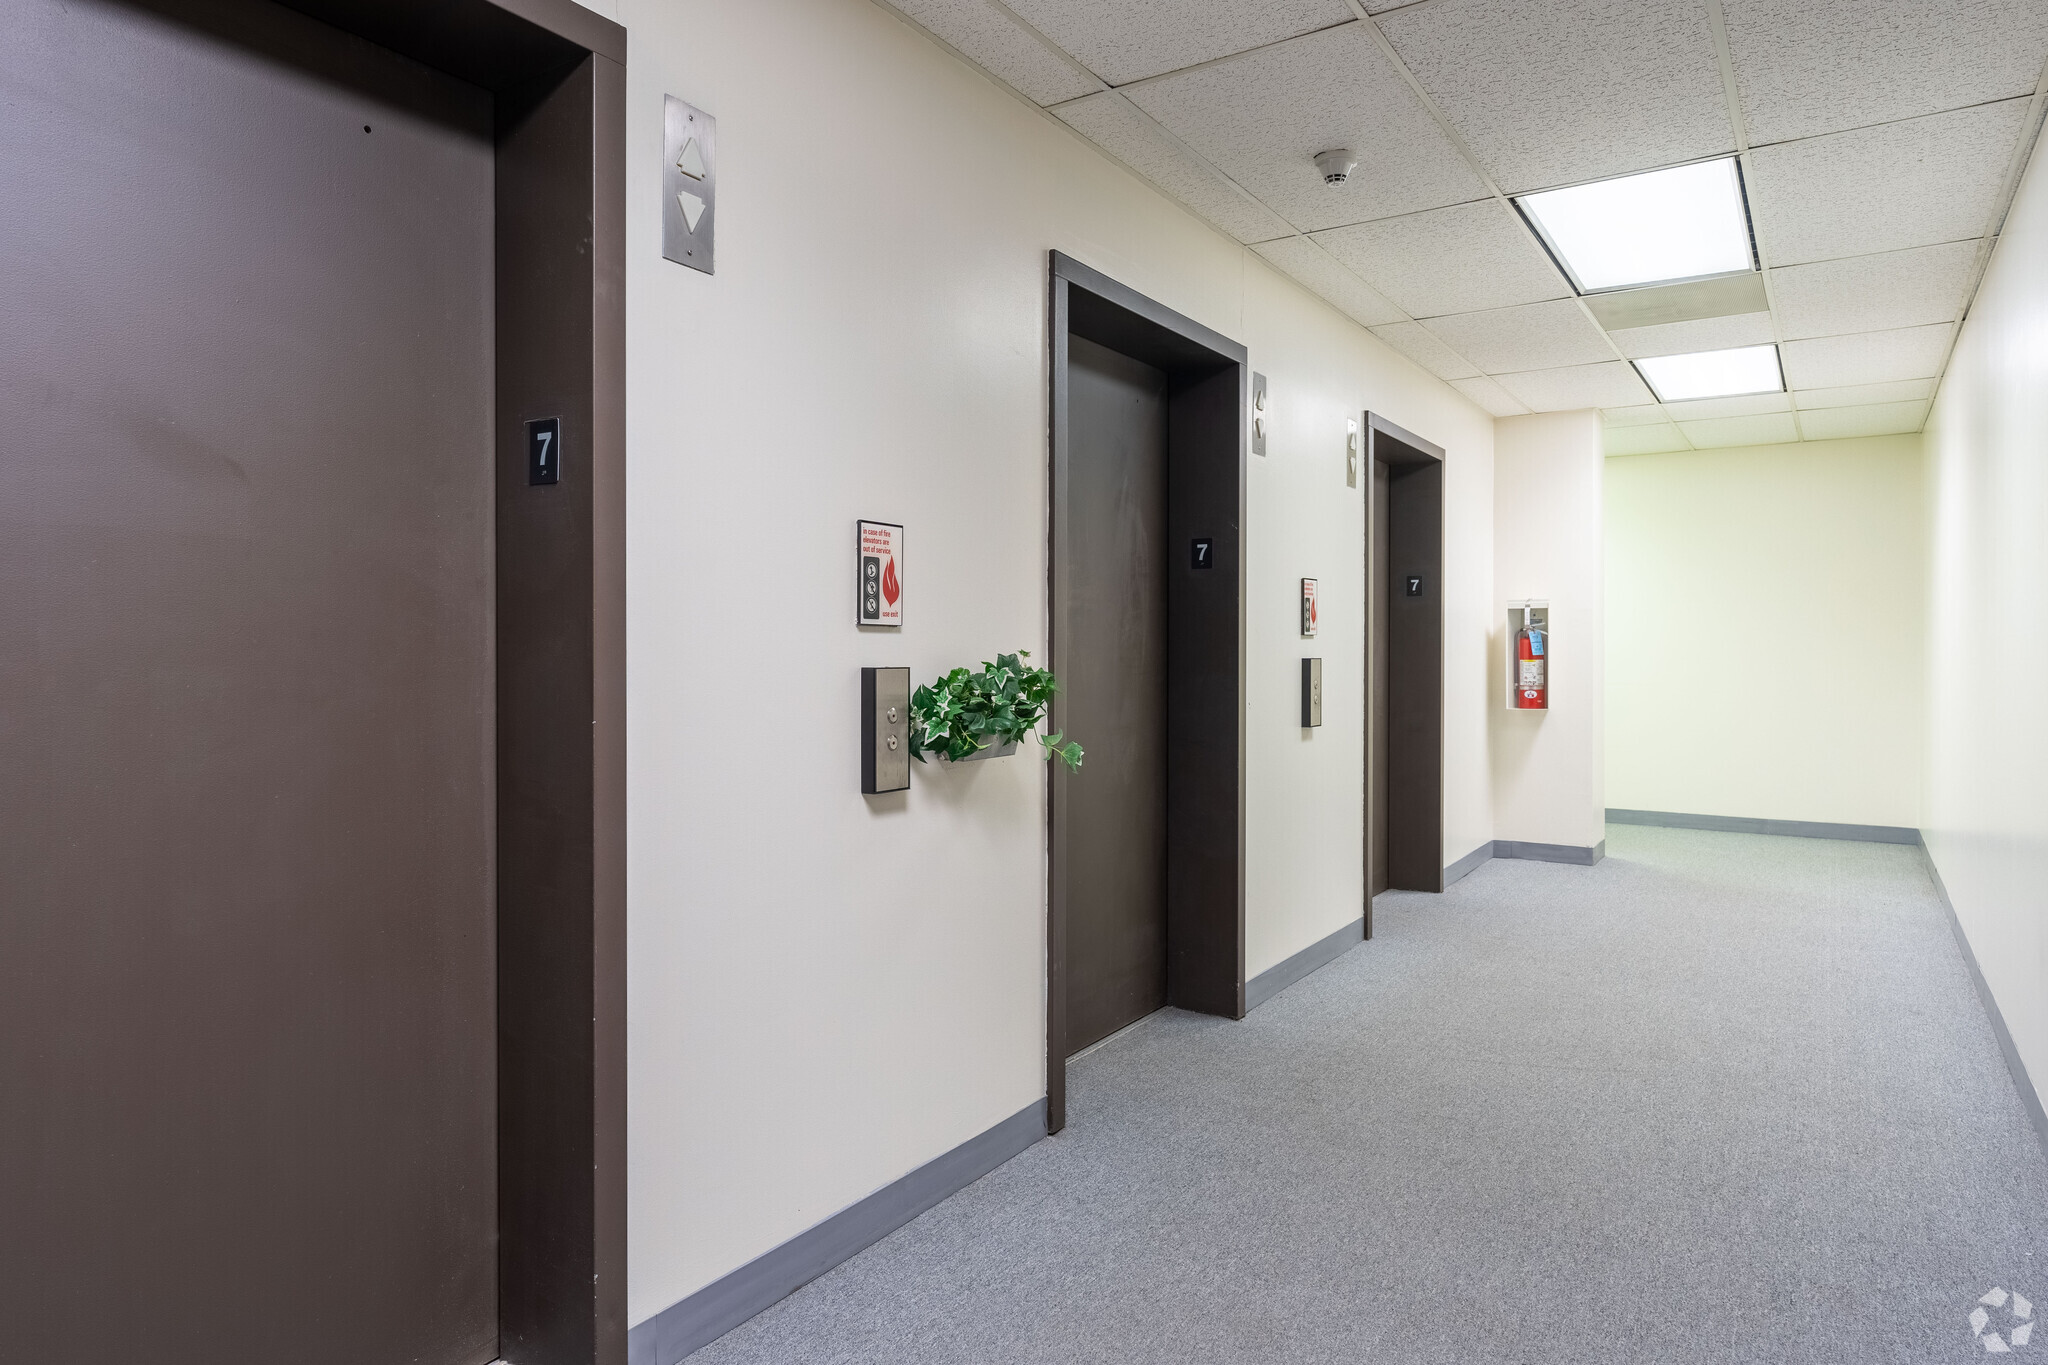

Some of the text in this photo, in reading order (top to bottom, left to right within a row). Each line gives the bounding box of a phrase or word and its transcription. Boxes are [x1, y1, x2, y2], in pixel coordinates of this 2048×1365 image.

[537, 431, 552, 466] 7
[863, 536, 882, 544] elevators
[1196, 543, 1208, 561] 7
[1410, 579, 1419, 591] 7
